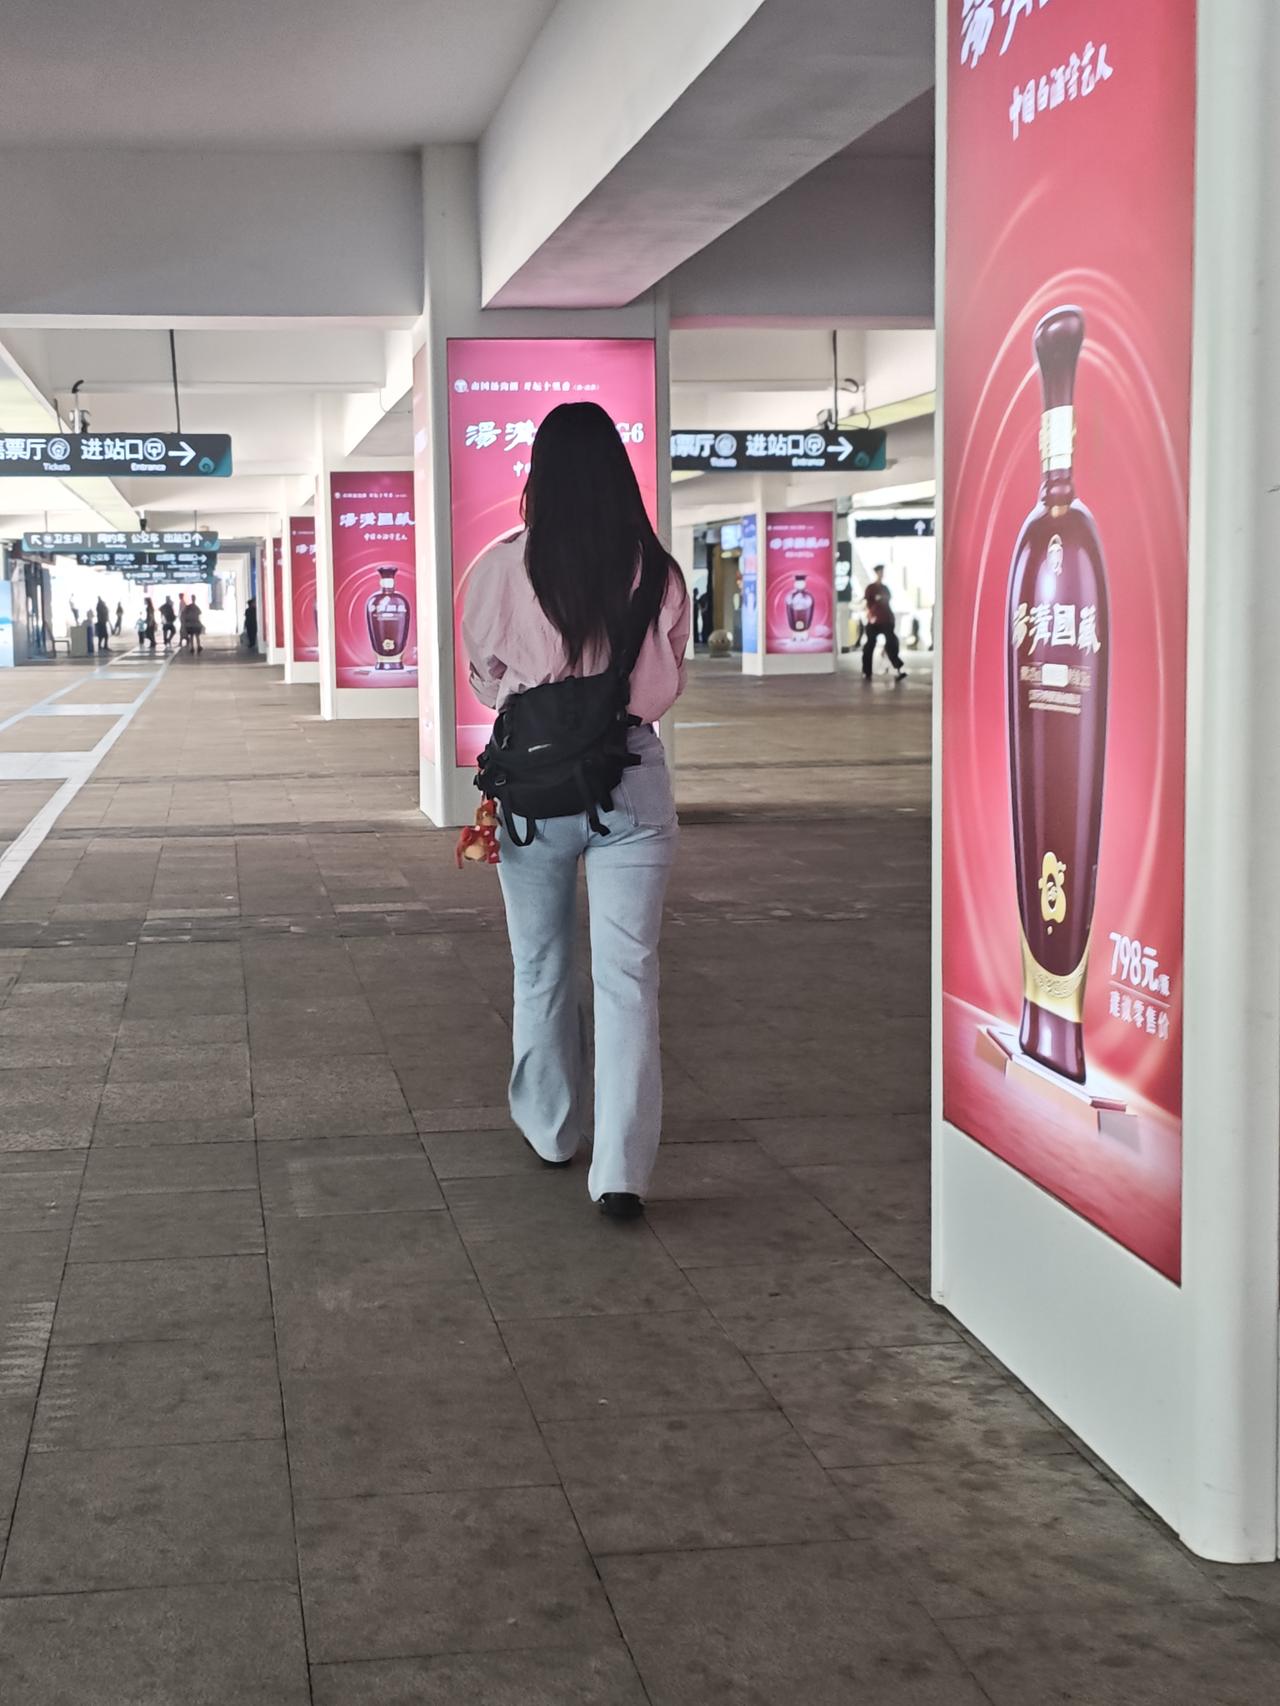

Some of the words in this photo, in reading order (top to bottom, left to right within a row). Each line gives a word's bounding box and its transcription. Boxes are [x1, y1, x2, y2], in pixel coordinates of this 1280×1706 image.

[81, 438, 144, 460] 进站口
[746, 434, 804, 456] 进站口
